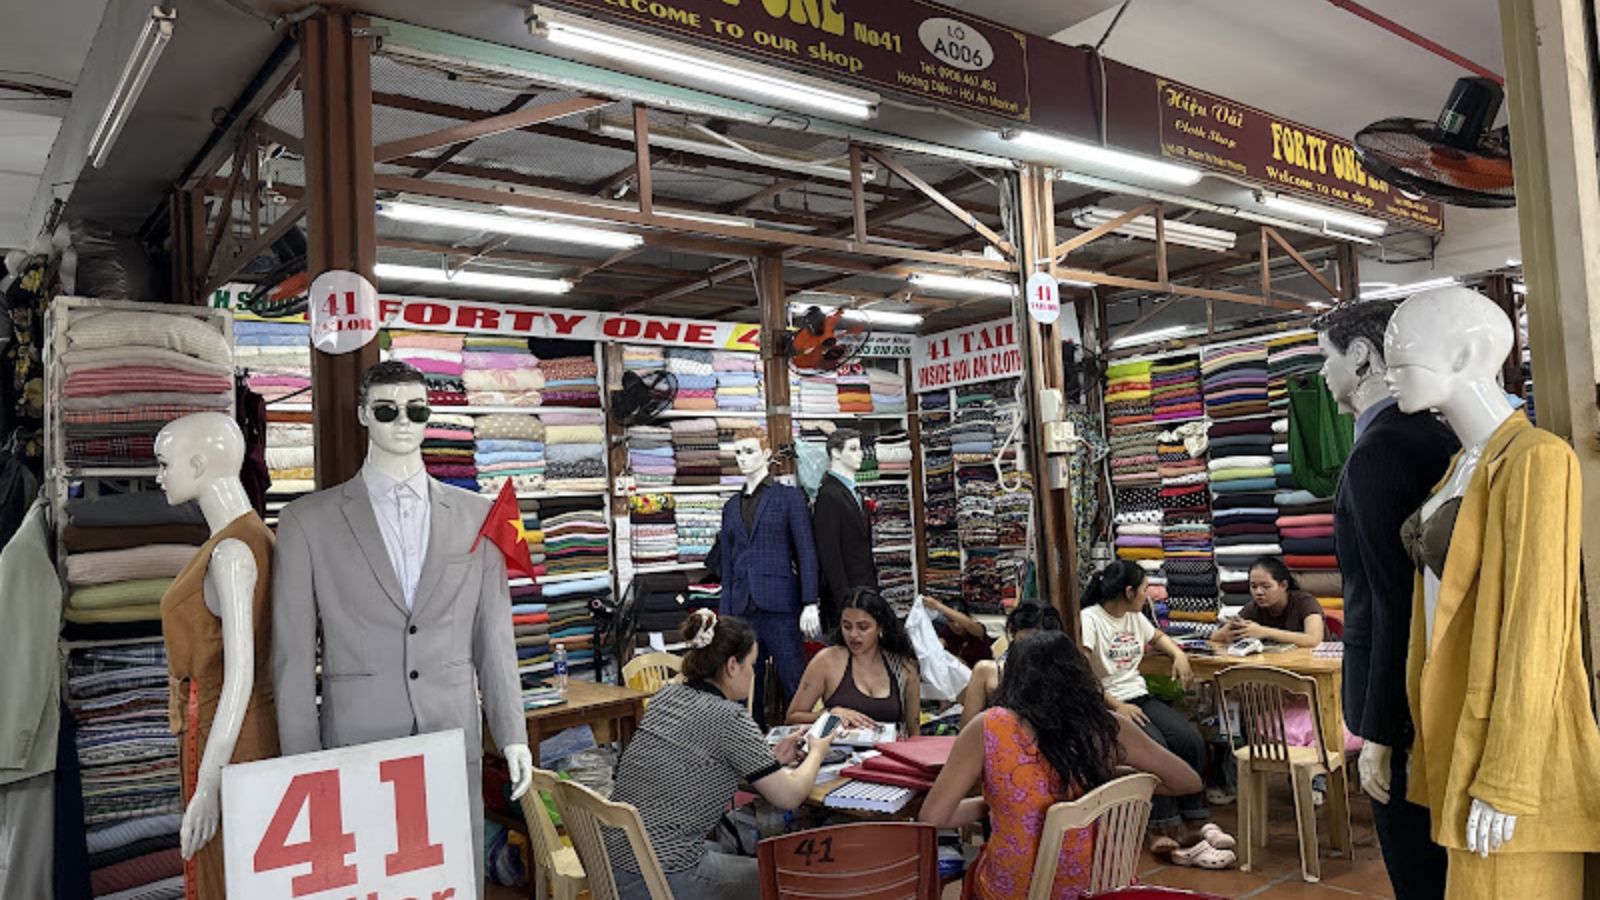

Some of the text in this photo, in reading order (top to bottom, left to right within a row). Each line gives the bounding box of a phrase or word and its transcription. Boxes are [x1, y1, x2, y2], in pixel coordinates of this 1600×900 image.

[933, 37, 984, 67] A006
[1271, 121, 1327, 175] FORTY
[321, 291, 356, 316] 41
[1034, 284, 1051, 301] 41
[378, 299, 587, 335] FORTY
[603, 317, 717, 344] ONE
[927, 337, 951, 360] 41
[918, 363, 951, 388] INSIDE
[253, 755, 444, 898] 41
[794, 836, 835, 867] 41
